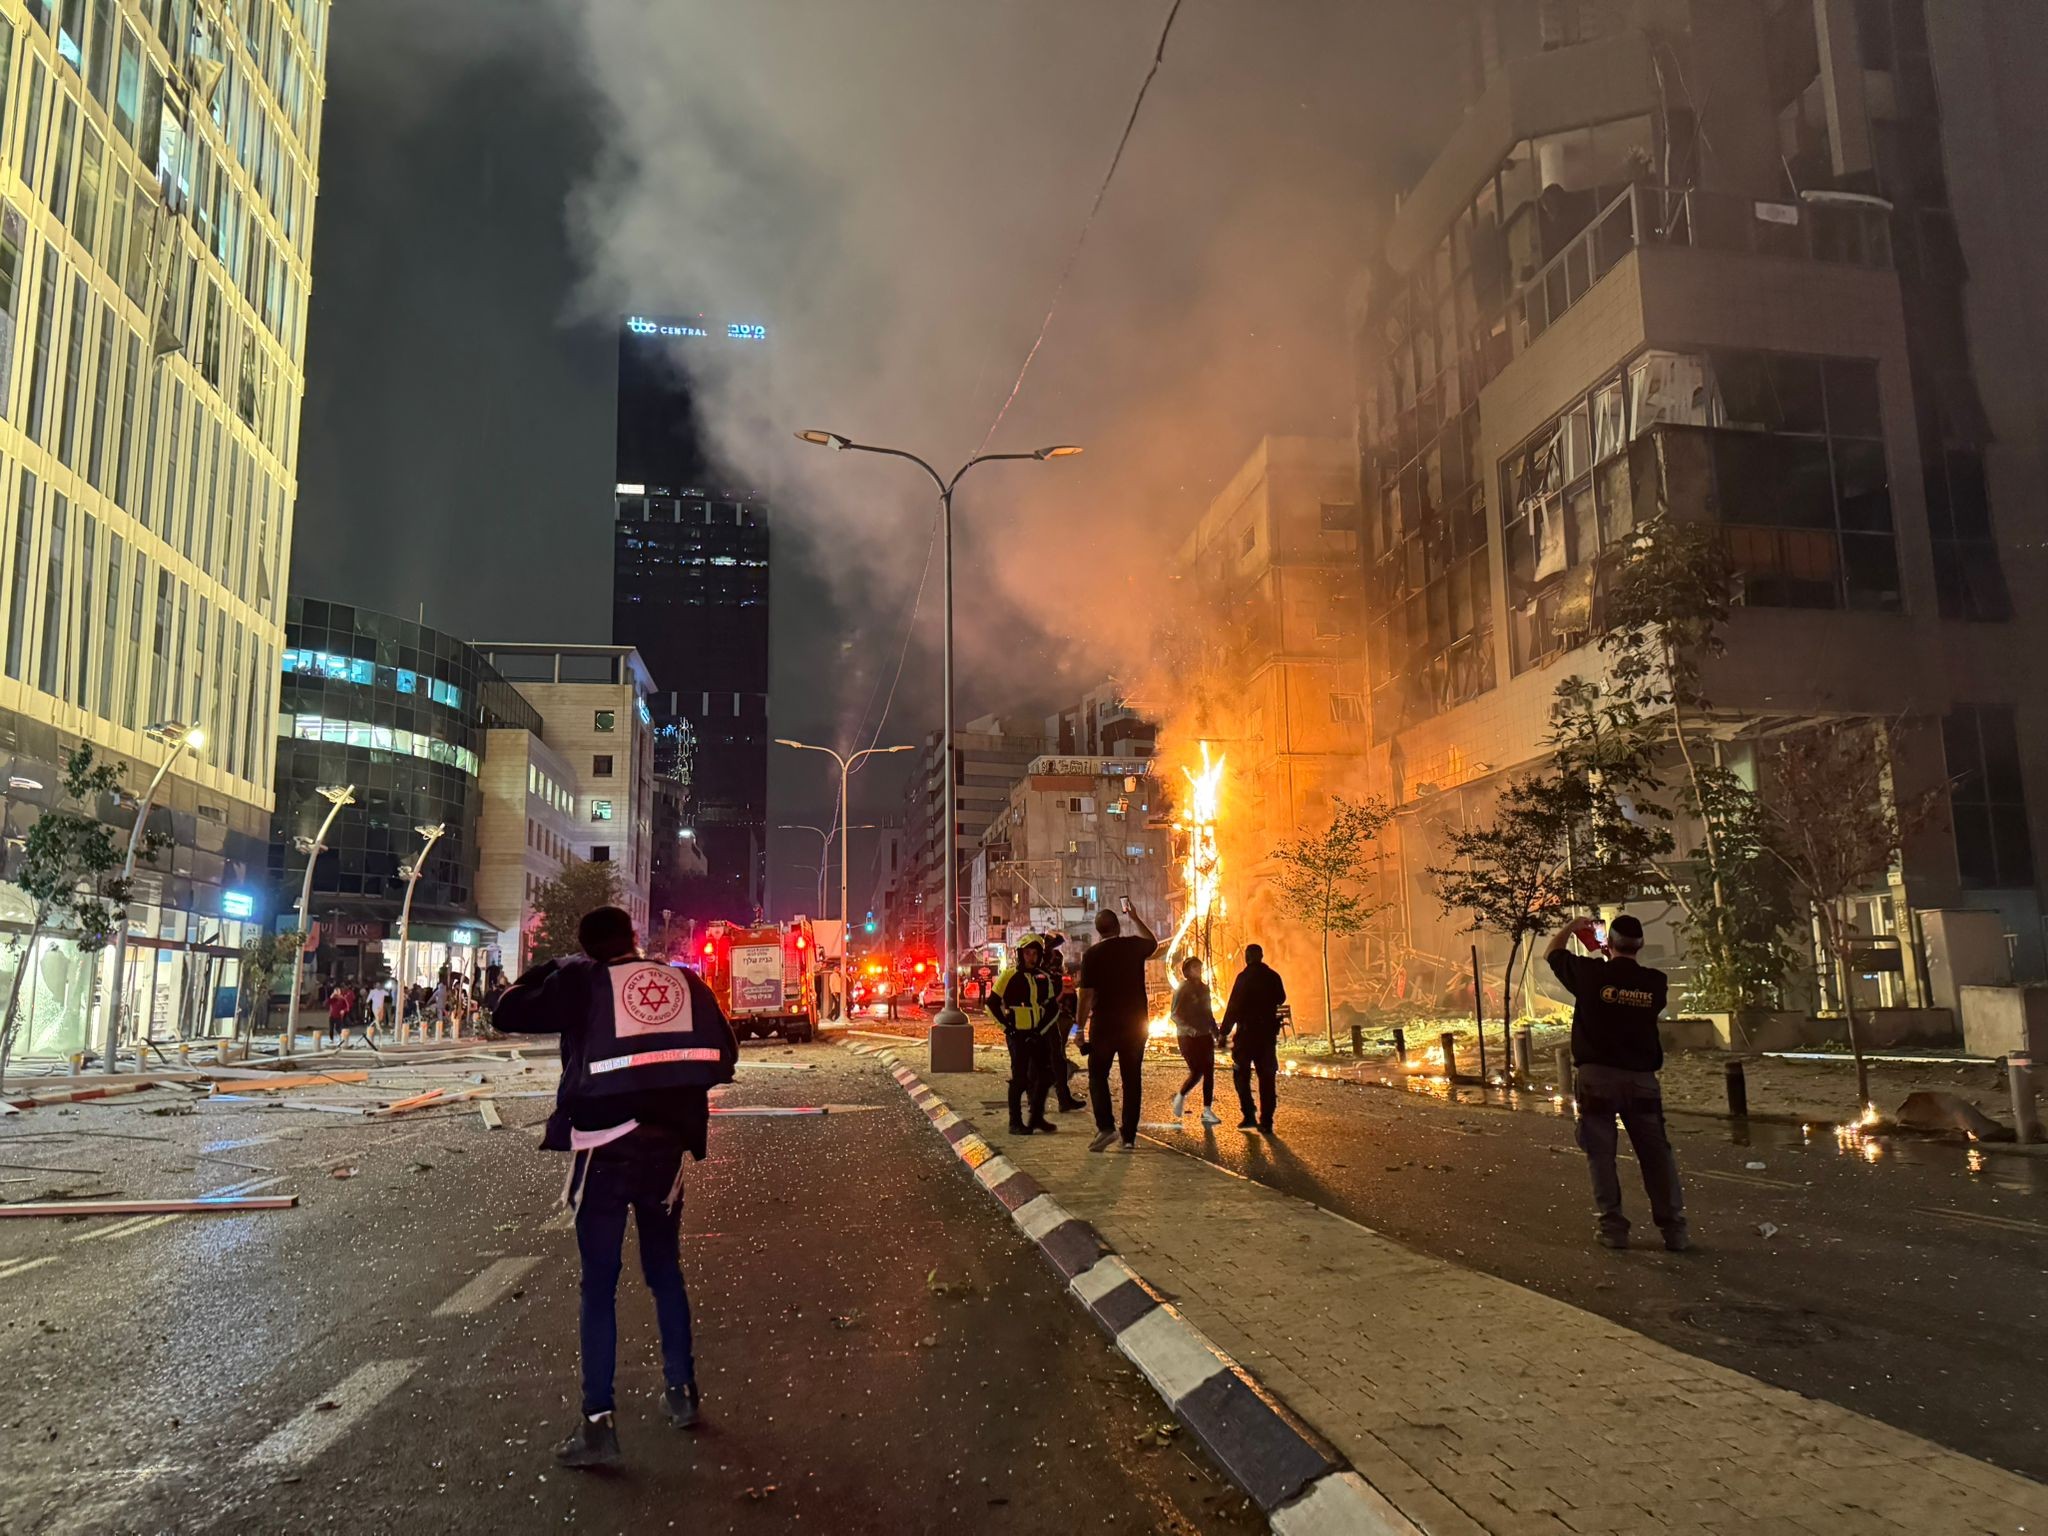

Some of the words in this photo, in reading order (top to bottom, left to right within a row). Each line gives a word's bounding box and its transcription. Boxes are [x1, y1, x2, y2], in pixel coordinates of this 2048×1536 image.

[660, 325, 708, 337] CENTRAL
[628, 974, 645, 990] אדום
[627, 993, 646, 1019] MAGEN
[647, 1010, 672, 1021] DAVID
[671, 990, 680, 1014] ADOM
